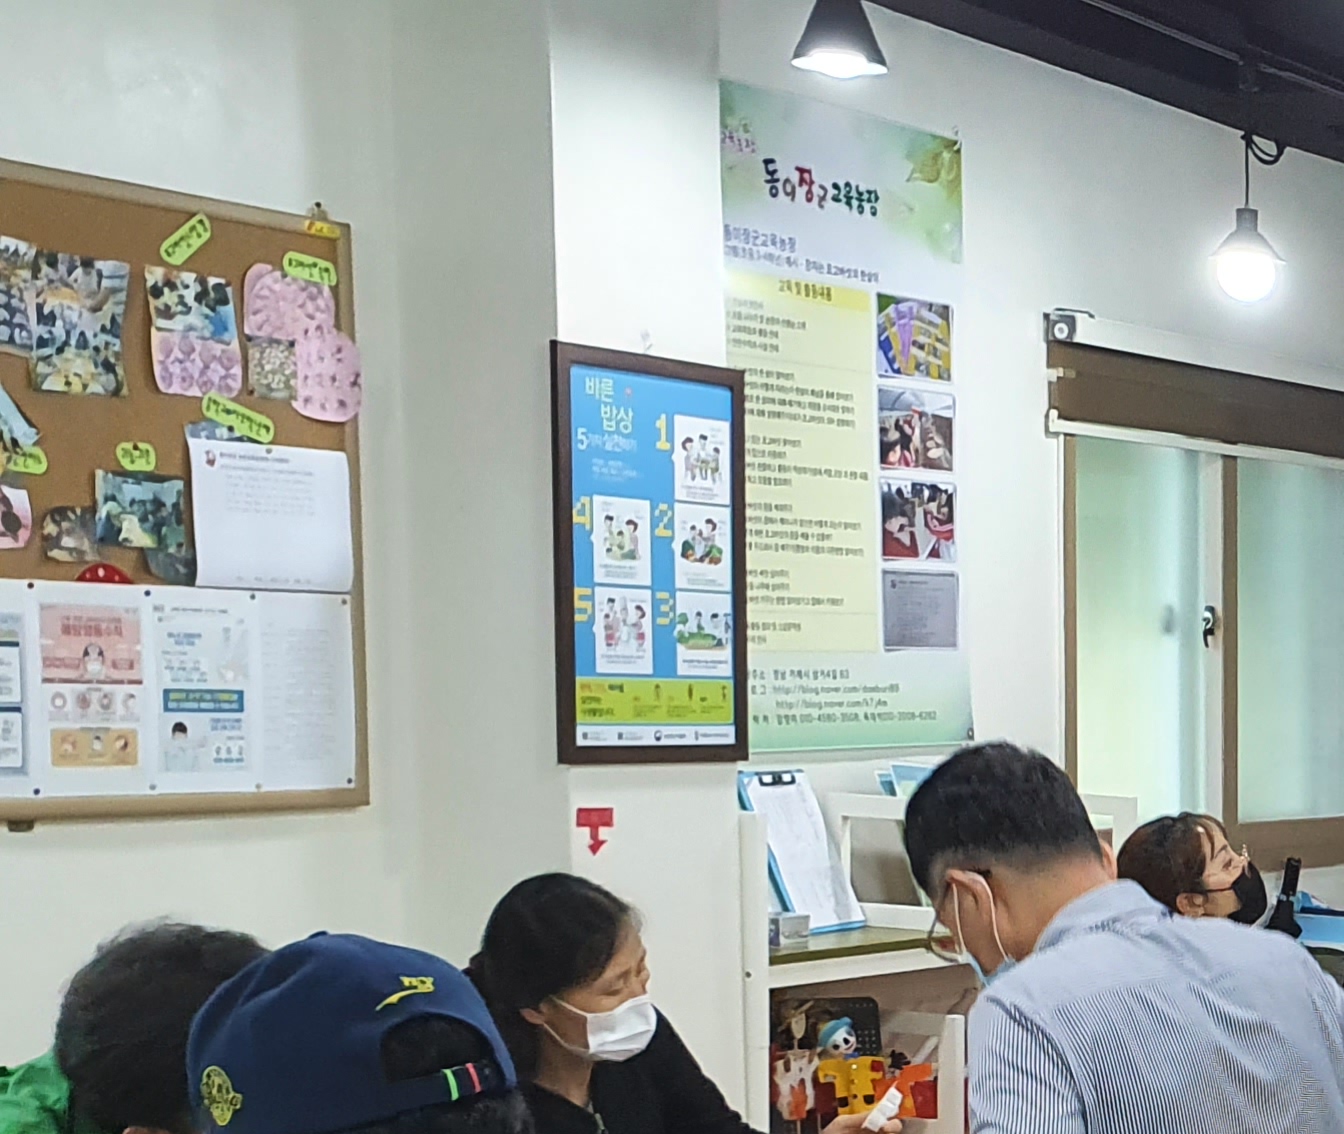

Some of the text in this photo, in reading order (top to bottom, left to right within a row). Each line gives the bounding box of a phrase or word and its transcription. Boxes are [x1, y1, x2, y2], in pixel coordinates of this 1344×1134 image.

[831, 181, 880, 216] 교육농장
[585, 377, 614, 402] 바른
[601, 404, 634, 434] 밥상
[656, 413, 671, 450] 1
[573, 496, 591, 531] 4
[655, 503, 672, 537] 2
[574, 587, 592, 622] 5
[656, 592, 674, 626] 3
